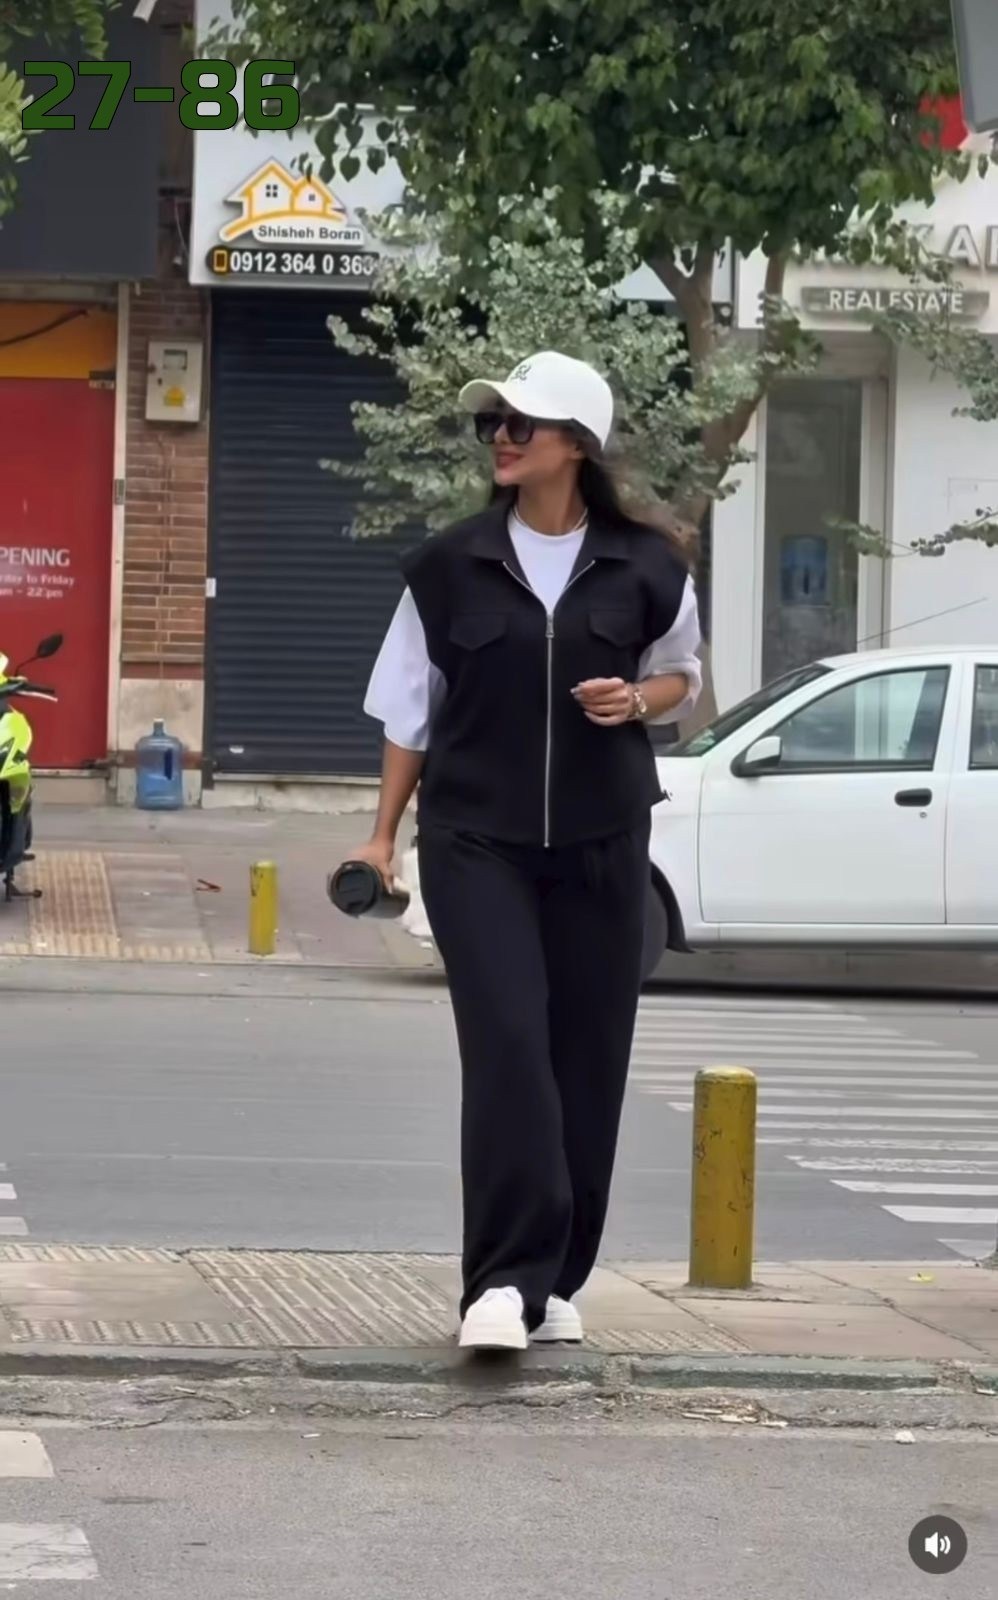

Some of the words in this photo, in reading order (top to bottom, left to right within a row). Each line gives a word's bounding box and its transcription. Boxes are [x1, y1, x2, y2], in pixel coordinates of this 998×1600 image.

[258, 225, 315, 239] Shisheh
[319, 227, 361, 241] Boran
[230, 251, 277, 273] 0912
[281, 253, 316, 274] 364
[322, 254, 335, 275] 0
